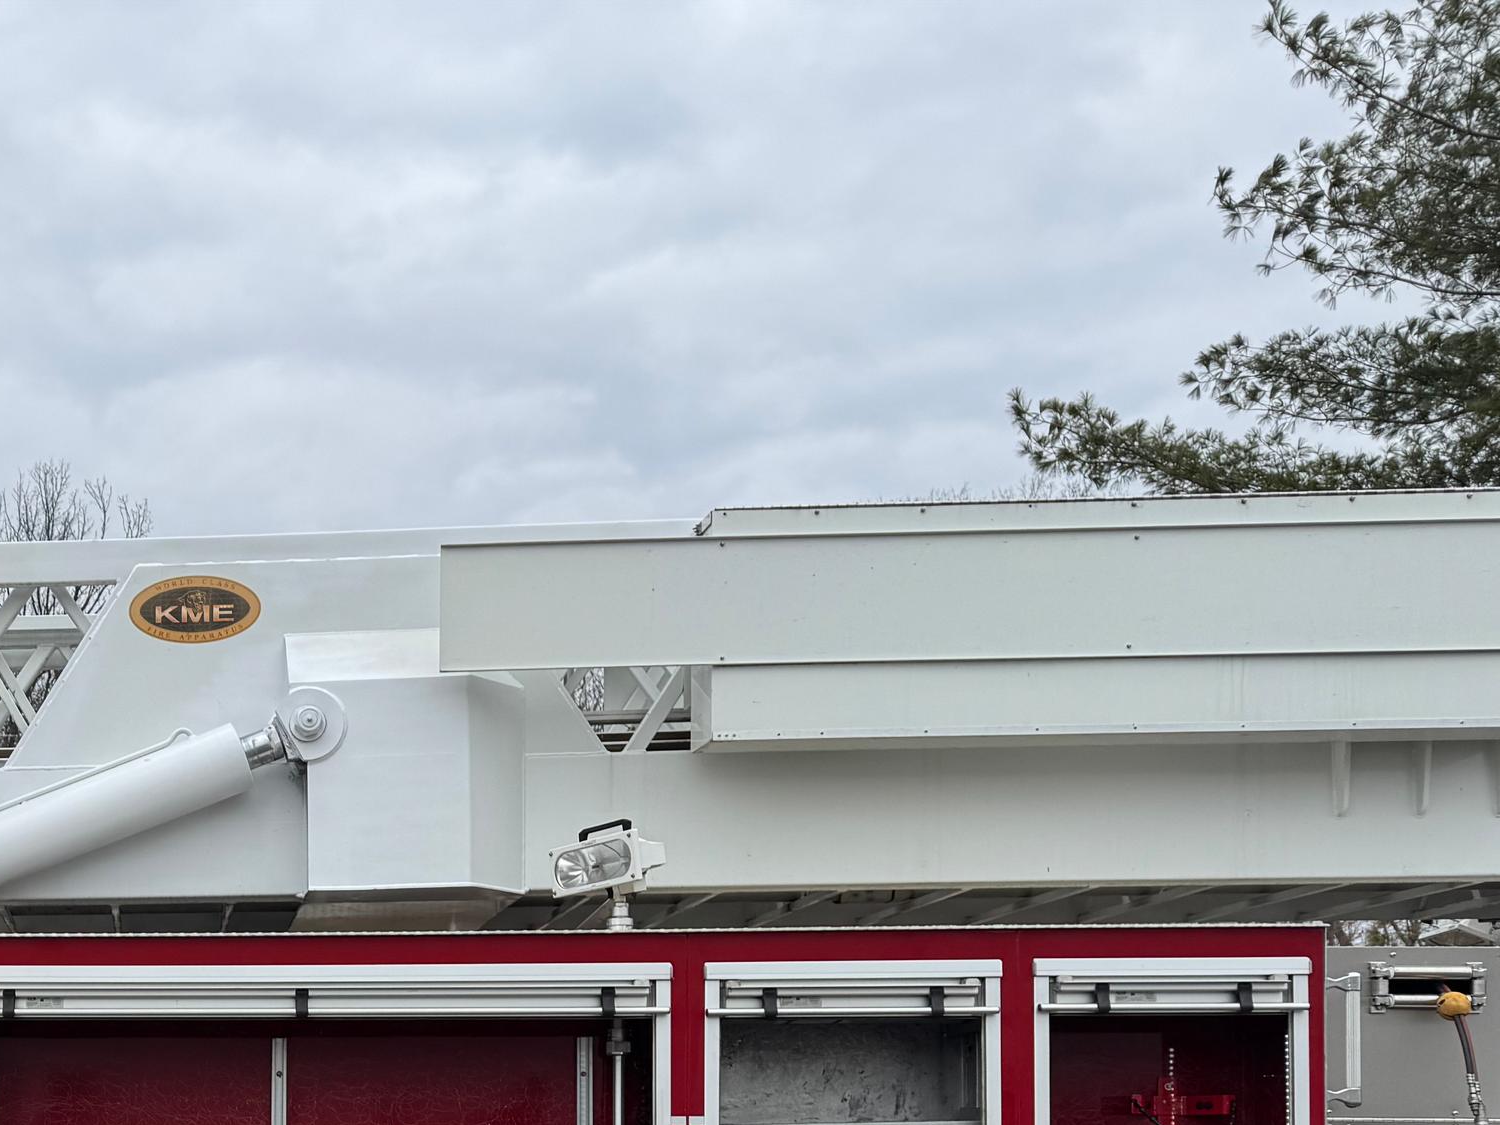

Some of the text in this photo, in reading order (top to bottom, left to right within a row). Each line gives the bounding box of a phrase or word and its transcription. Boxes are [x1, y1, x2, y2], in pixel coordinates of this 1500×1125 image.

[154, 578, 237, 592] WORLD CLASS
[155, 604, 235, 625] KME
[147, 624, 245, 641] FIRE APPARATUS
